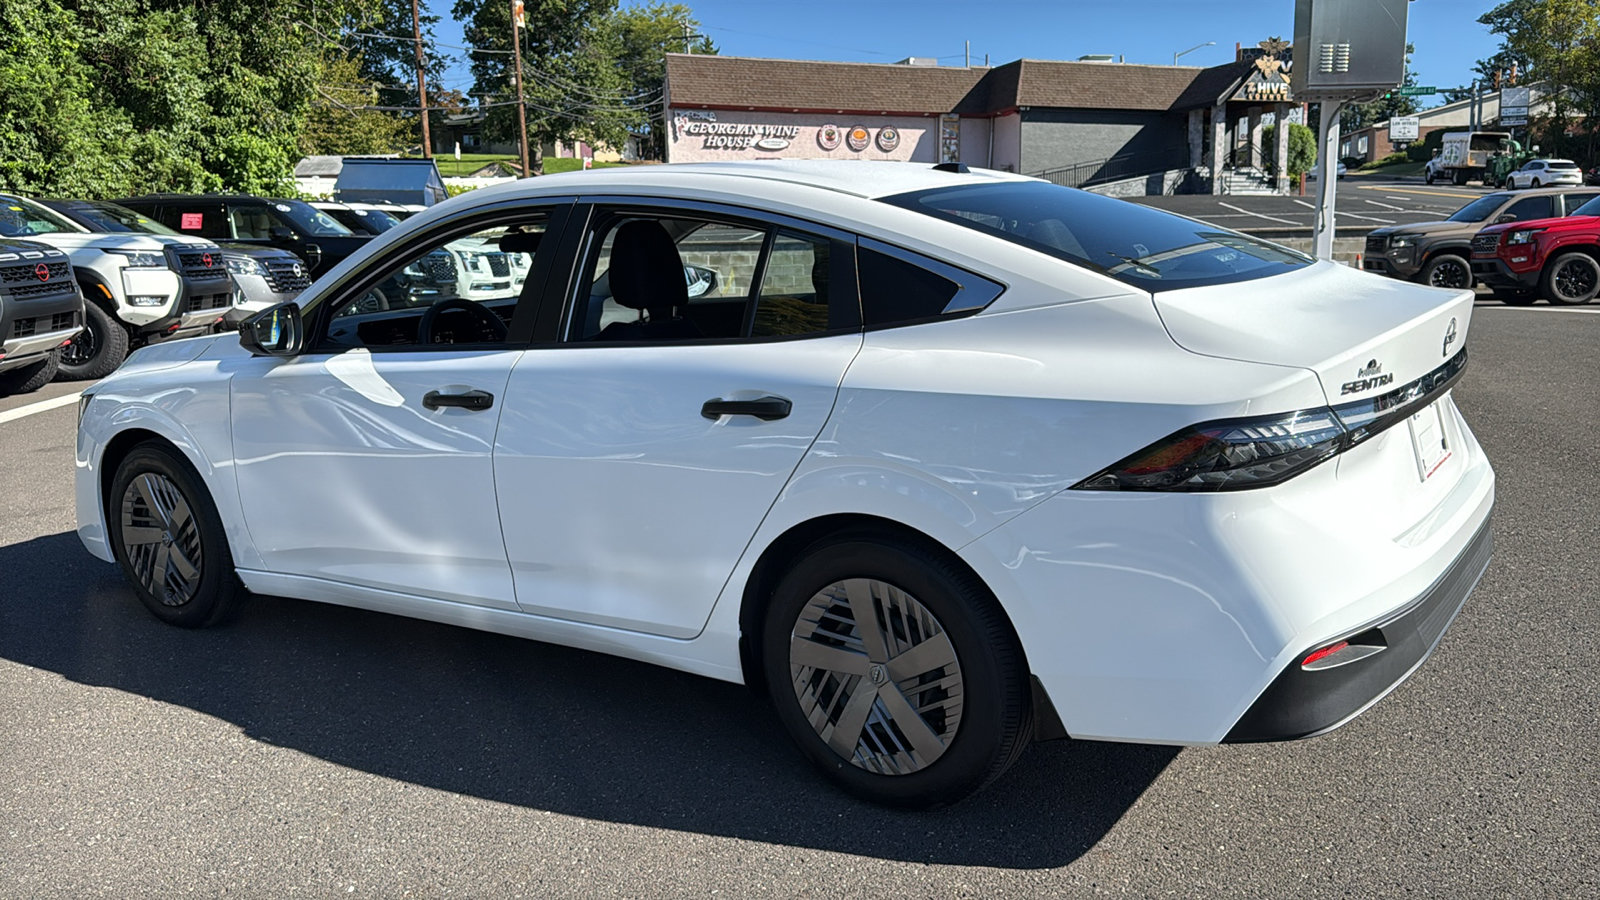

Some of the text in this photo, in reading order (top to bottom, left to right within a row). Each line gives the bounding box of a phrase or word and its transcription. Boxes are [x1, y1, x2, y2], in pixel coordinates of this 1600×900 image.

[1257, 82, 1288, 94] HIVE
[1248, 93, 1288, 101] LOUNGE
[690, 122, 800, 137] GEORGIAN WINE
[706, 135, 751, 148] HOUSE
[1341, 372, 1394, 396] SENTRA
